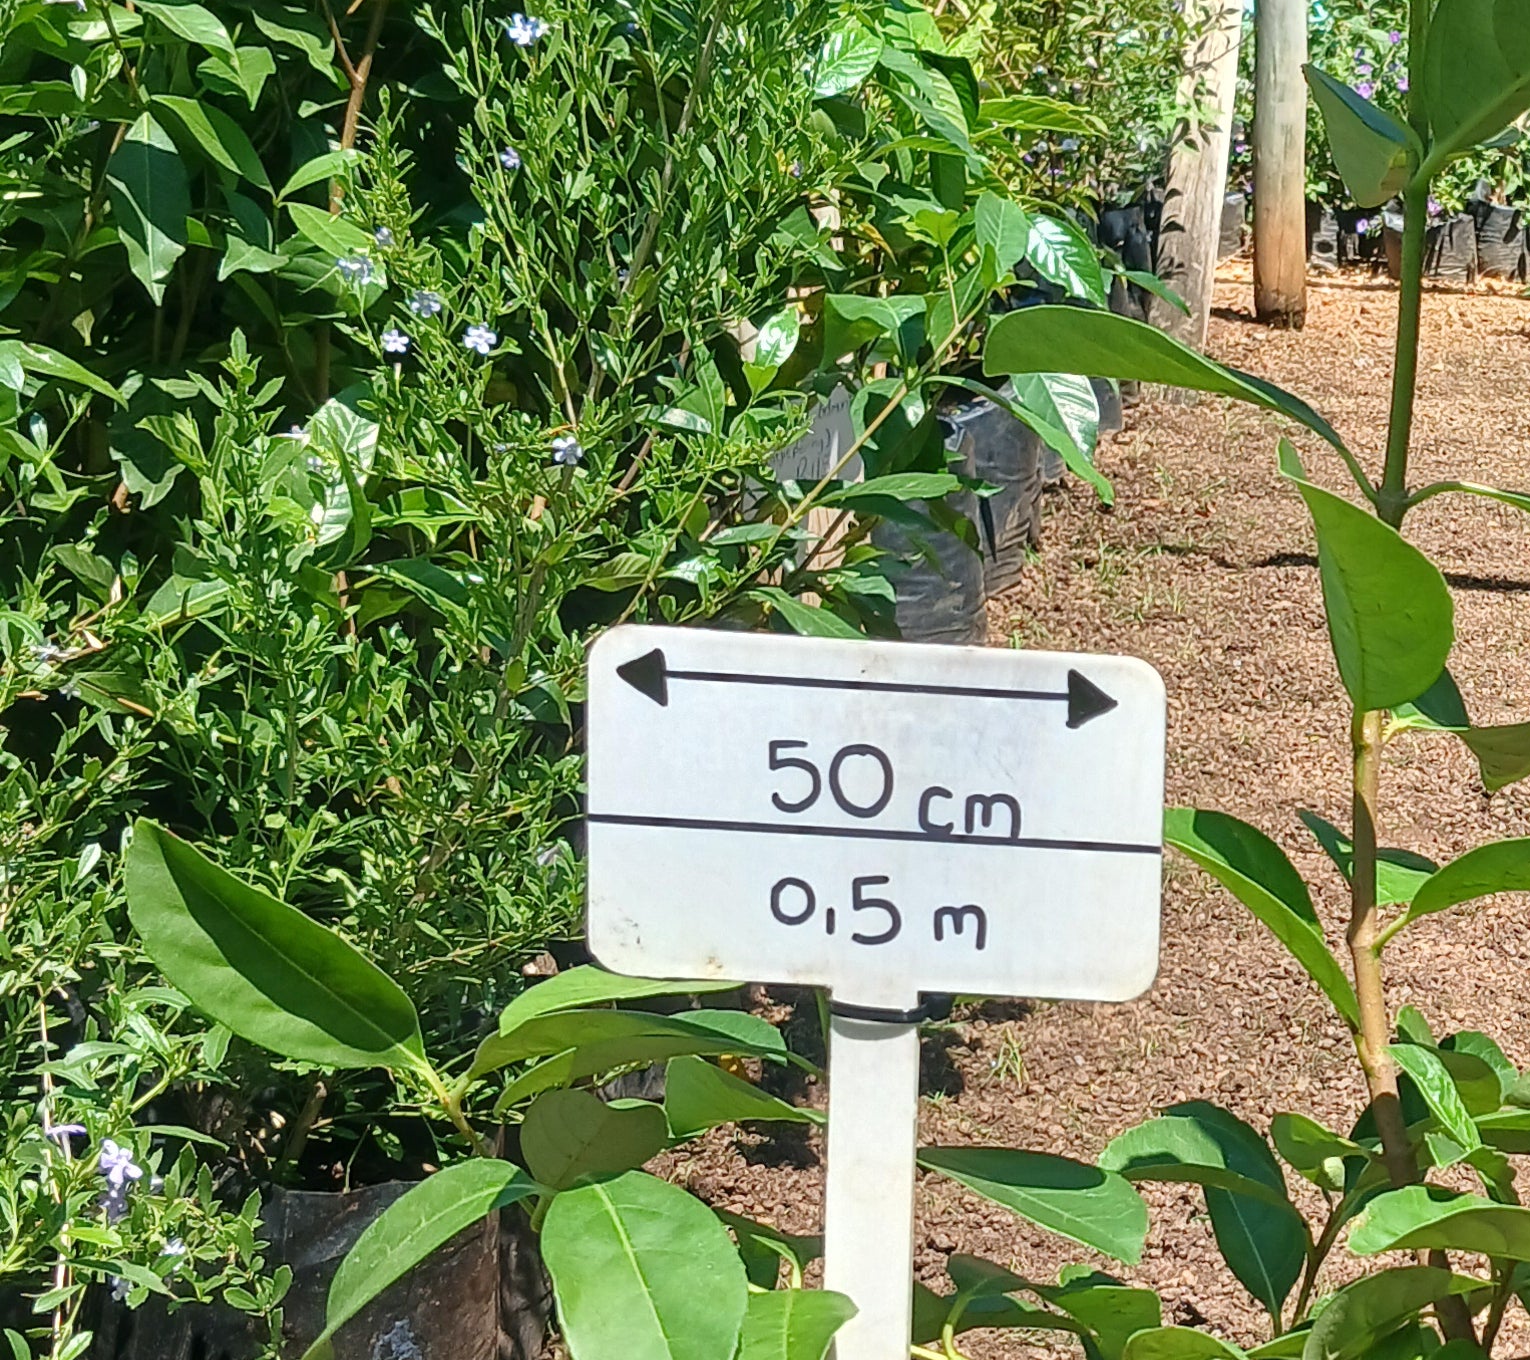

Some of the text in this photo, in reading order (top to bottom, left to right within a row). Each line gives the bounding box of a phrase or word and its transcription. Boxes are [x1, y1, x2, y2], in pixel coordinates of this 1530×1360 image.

[768, 738, 1023, 840] 50 cm
[769, 875, 987, 951] 0,5 m
